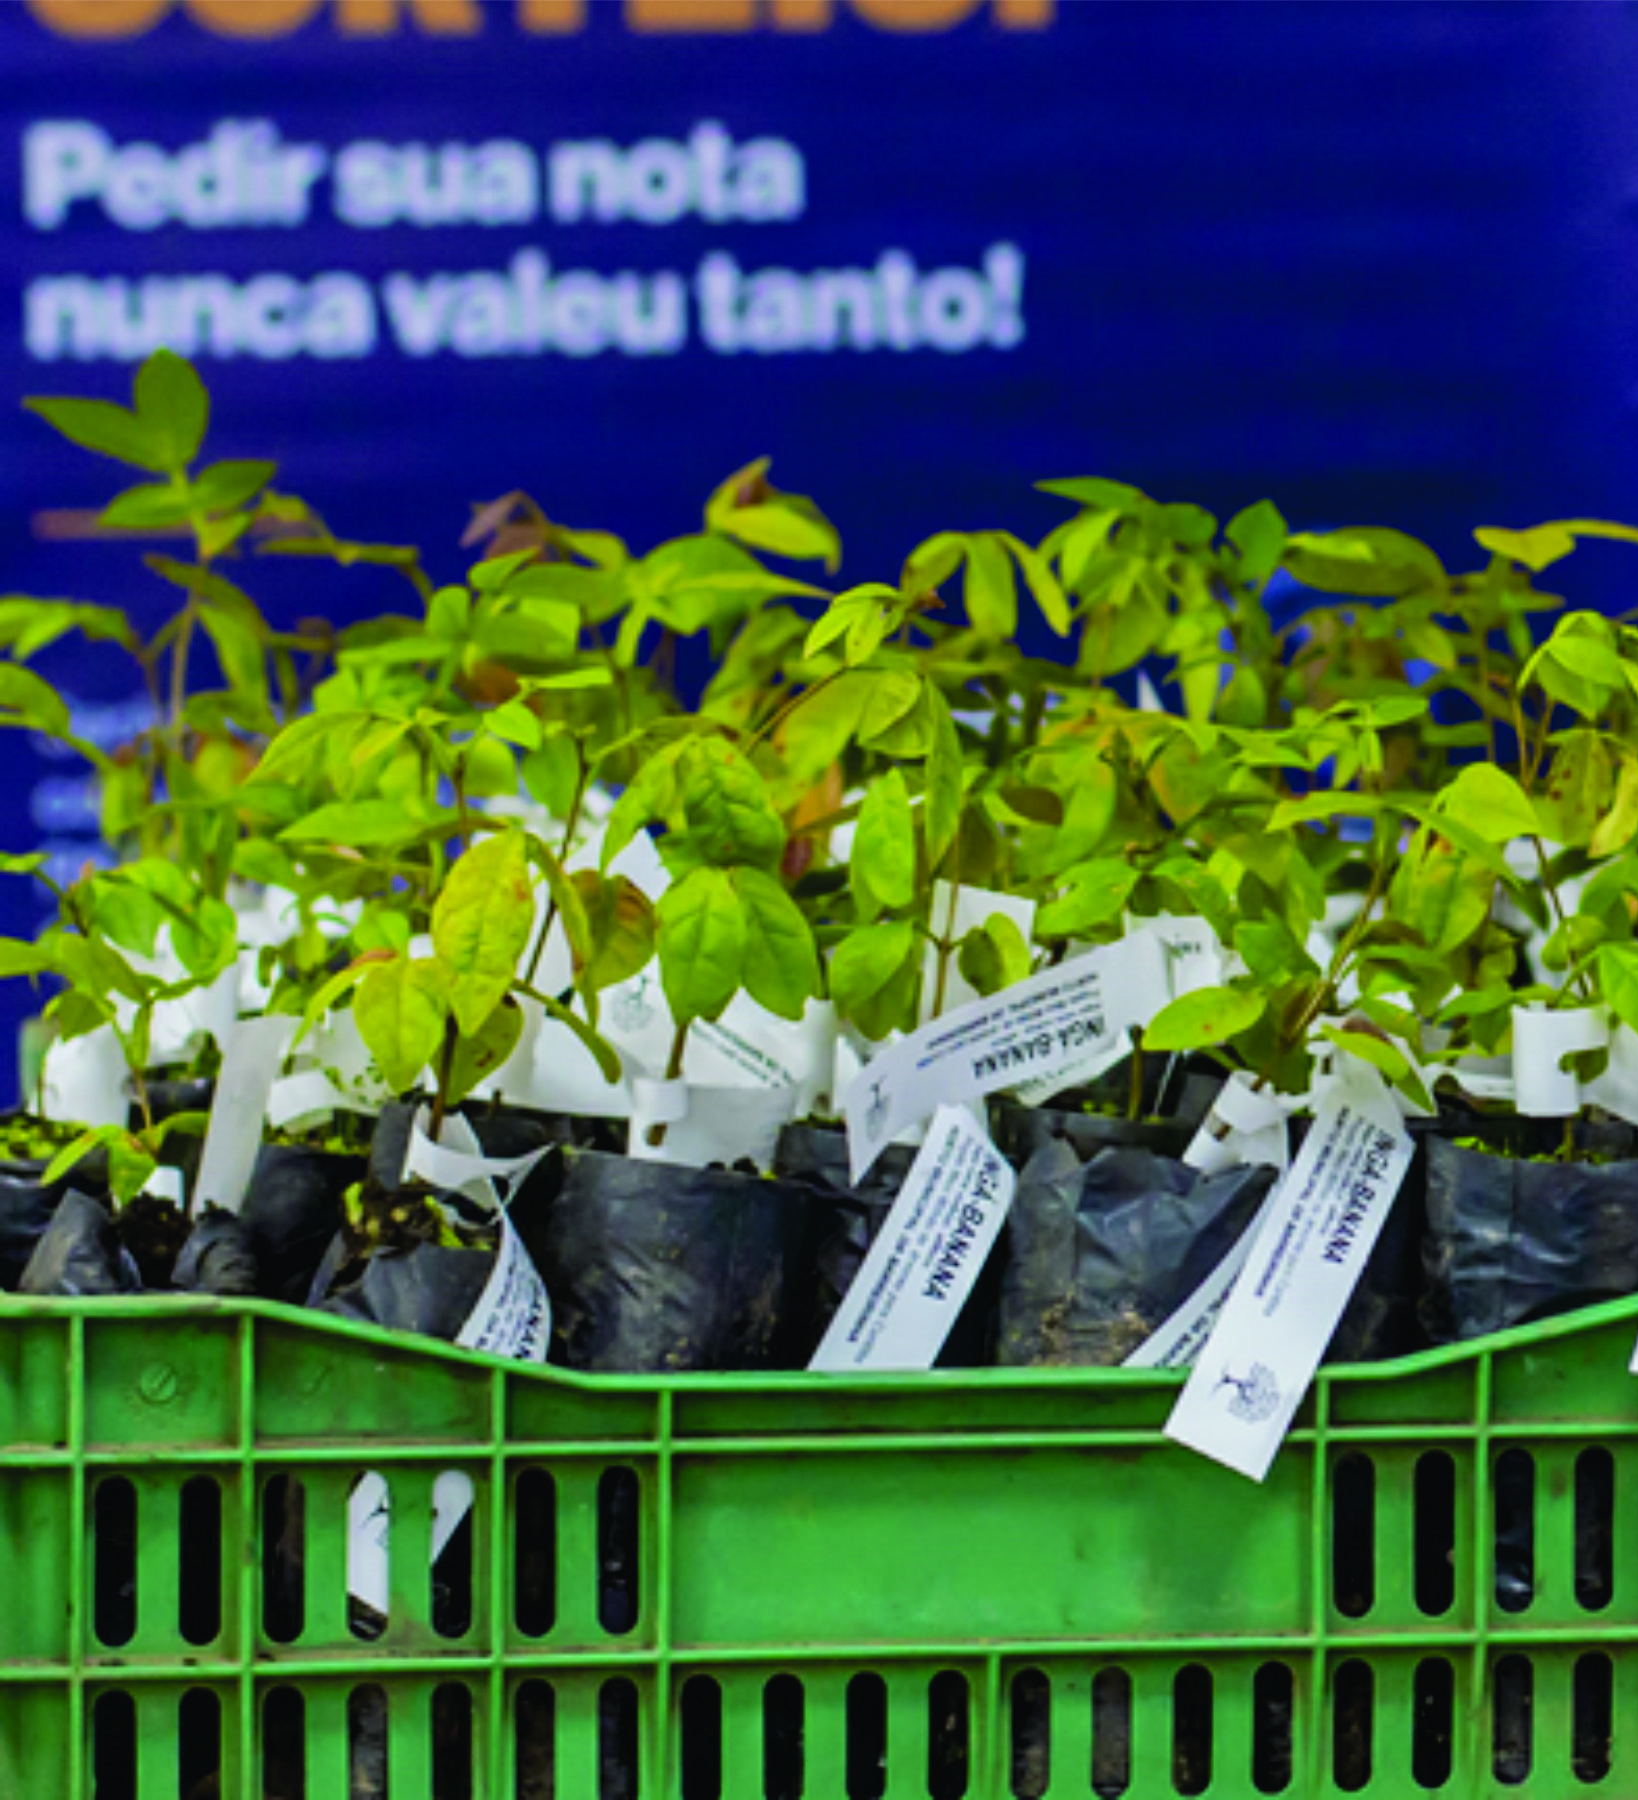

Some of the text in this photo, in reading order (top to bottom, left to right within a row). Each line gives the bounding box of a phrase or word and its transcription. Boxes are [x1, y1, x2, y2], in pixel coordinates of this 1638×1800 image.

[22, 118, 805, 230] Pedir sua nota
[23, 243, 1025, 360] nunca valeu tanto!
